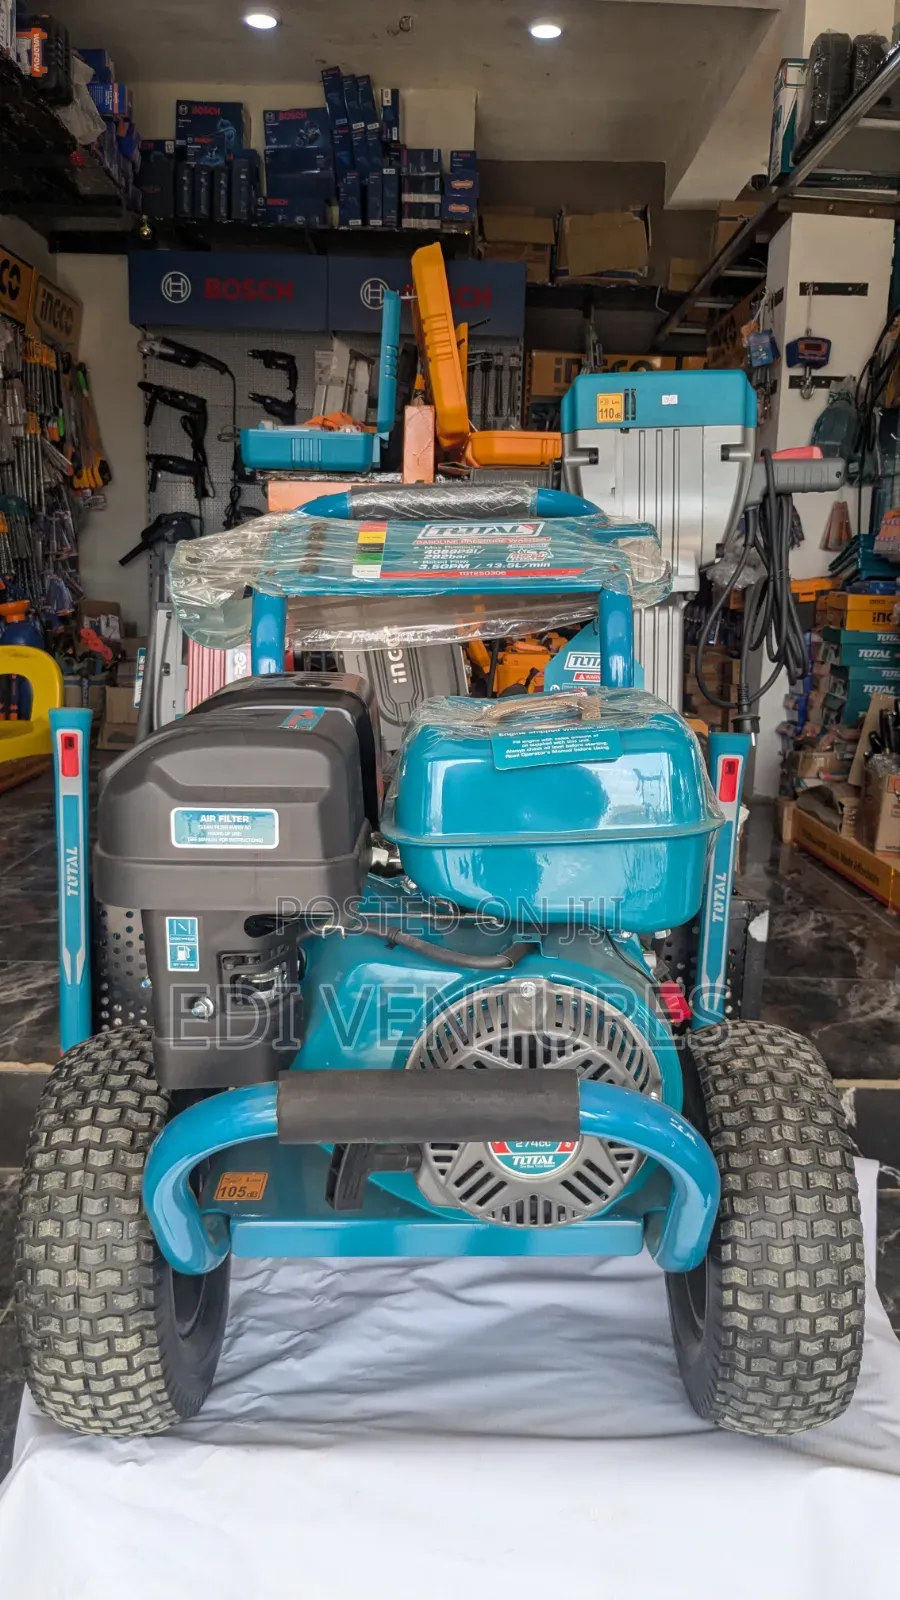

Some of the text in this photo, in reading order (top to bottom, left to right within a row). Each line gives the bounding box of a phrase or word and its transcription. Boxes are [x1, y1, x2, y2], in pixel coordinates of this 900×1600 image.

[32, 33, 40, 72] WADFOW
[191, 106, 221, 115] BOSCH
[278, 111, 307, 121] BOSCH
[204, 277, 294, 303] BOSCH
[599, 408, 614, 419] 110
[430, 525, 528, 536] TOTAL
[858, 649, 891, 659] TOTAL
[200, 814, 250, 823] AIR FILTER
[67, 846, 78, 897] TOTAL
[711, 872, 727, 923] TOTAL
[513, 1155, 556, 1165] TOTAL
[220, 1186, 259, 1198] 105 dB
